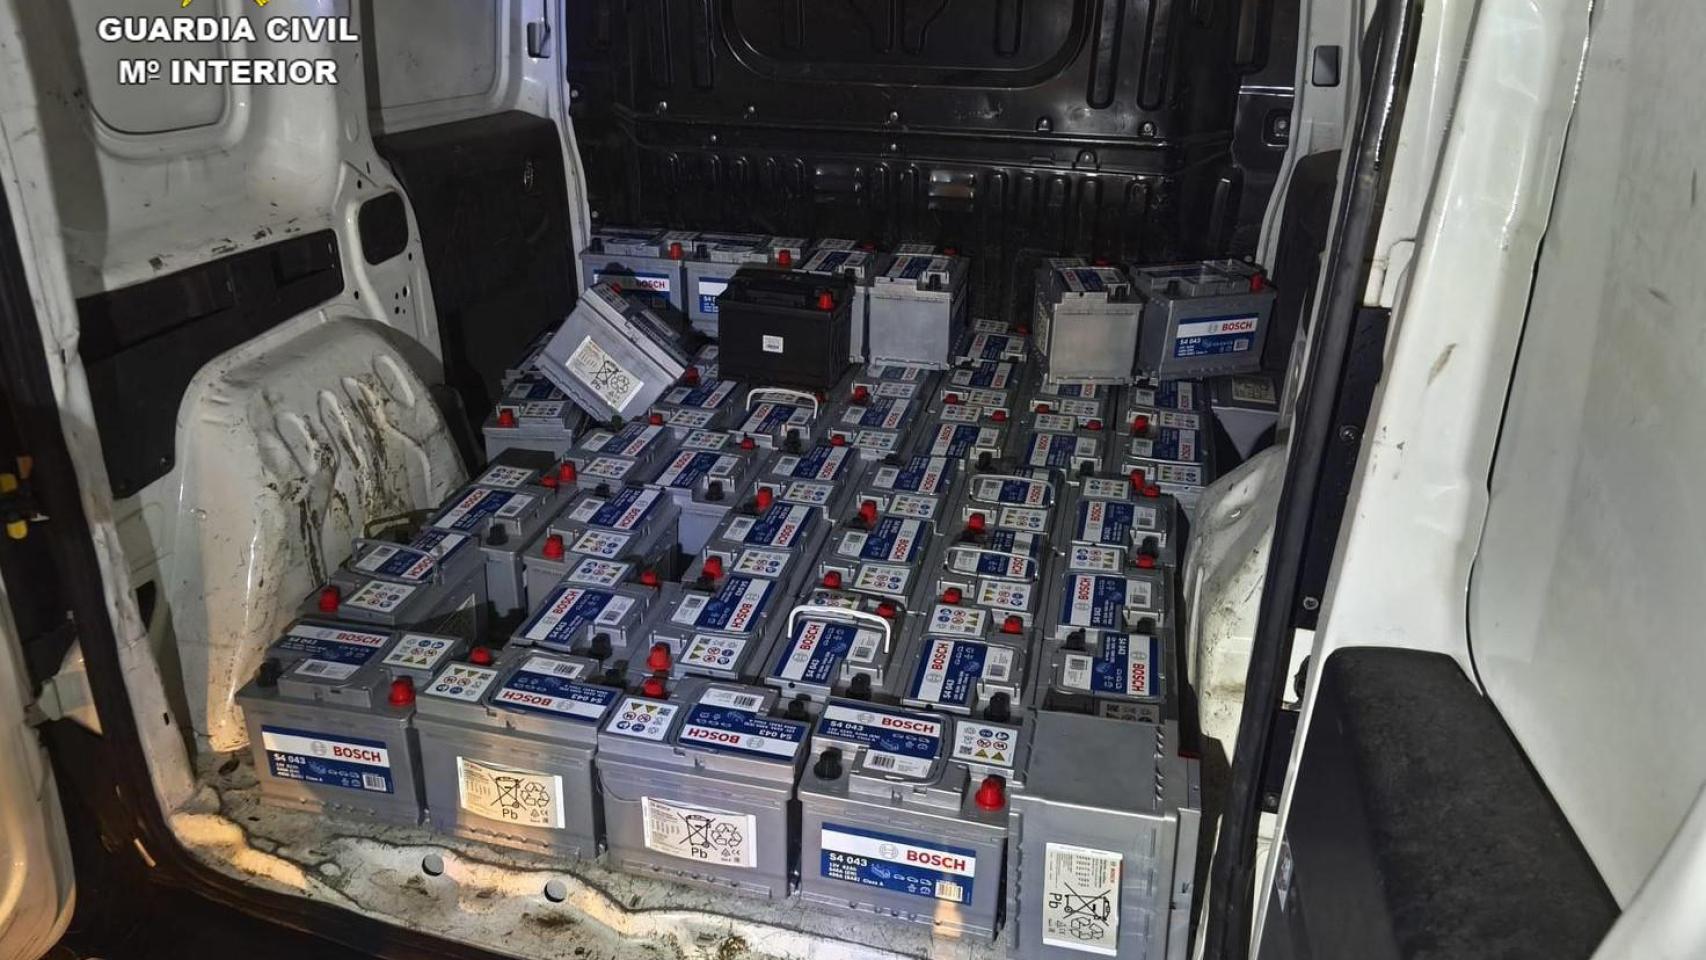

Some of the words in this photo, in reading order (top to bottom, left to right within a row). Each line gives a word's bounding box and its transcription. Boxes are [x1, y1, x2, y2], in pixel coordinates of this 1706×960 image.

[1222, 321, 1253, 331] BOSCH
[1078, 577, 1091, 601] BOSCH
[552, 591, 578, 615] BOSCH
[731, 602, 752, 629] BOSCH
[336, 632, 382, 645] BOSCH
[800, 624, 820, 650] BOSCH
[932, 643, 949, 671] BOSCH
[1132, 663, 1145, 692] BOSCH
[502, 691, 553, 706] BOSCH
[759, 729, 778, 737] 043
[830, 720, 843, 728] S4
[845, 723, 864, 731] 043
[881, 717, 934, 733] BOSCH
[687, 727, 740, 744] BOSCH
[780, 732, 792, 740] S4
[273, 753, 286, 762] S4
[287, 755, 306, 765] 043
[333, 745, 382, 763] BOSCH
[502, 808, 518, 820] Pb
[691, 847, 708, 859] Pb
[829, 852, 844, 863] S4
[846, 856, 868, 867] 043
[906, 850, 966, 871] BOSCH
[1048, 892, 1063, 909] Pb
